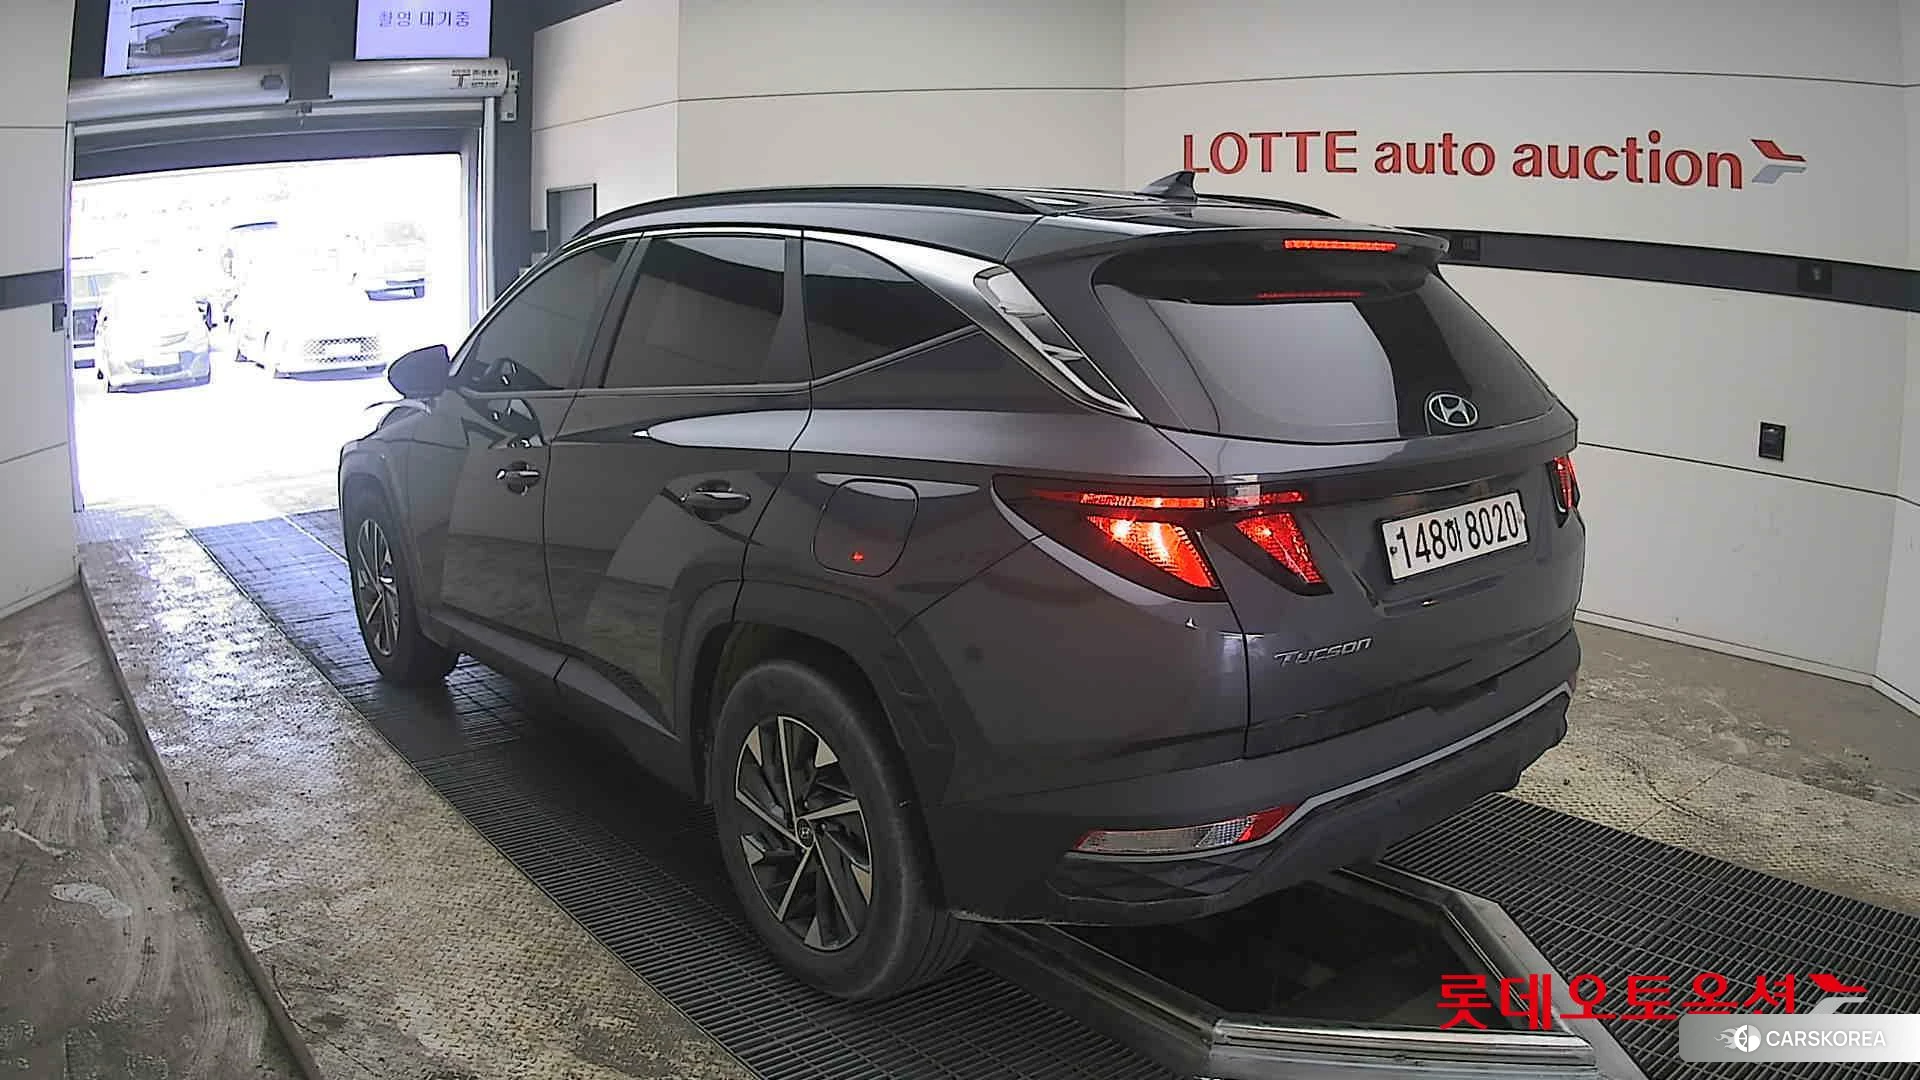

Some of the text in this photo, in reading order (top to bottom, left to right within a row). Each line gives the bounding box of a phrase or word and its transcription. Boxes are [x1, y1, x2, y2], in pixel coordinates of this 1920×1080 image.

[420, 10, 470, 27] 대기중
[1184, 129, 1743, 190] LOTTE auto auction
[1396, 501, 1519, 569] 148하 8020
